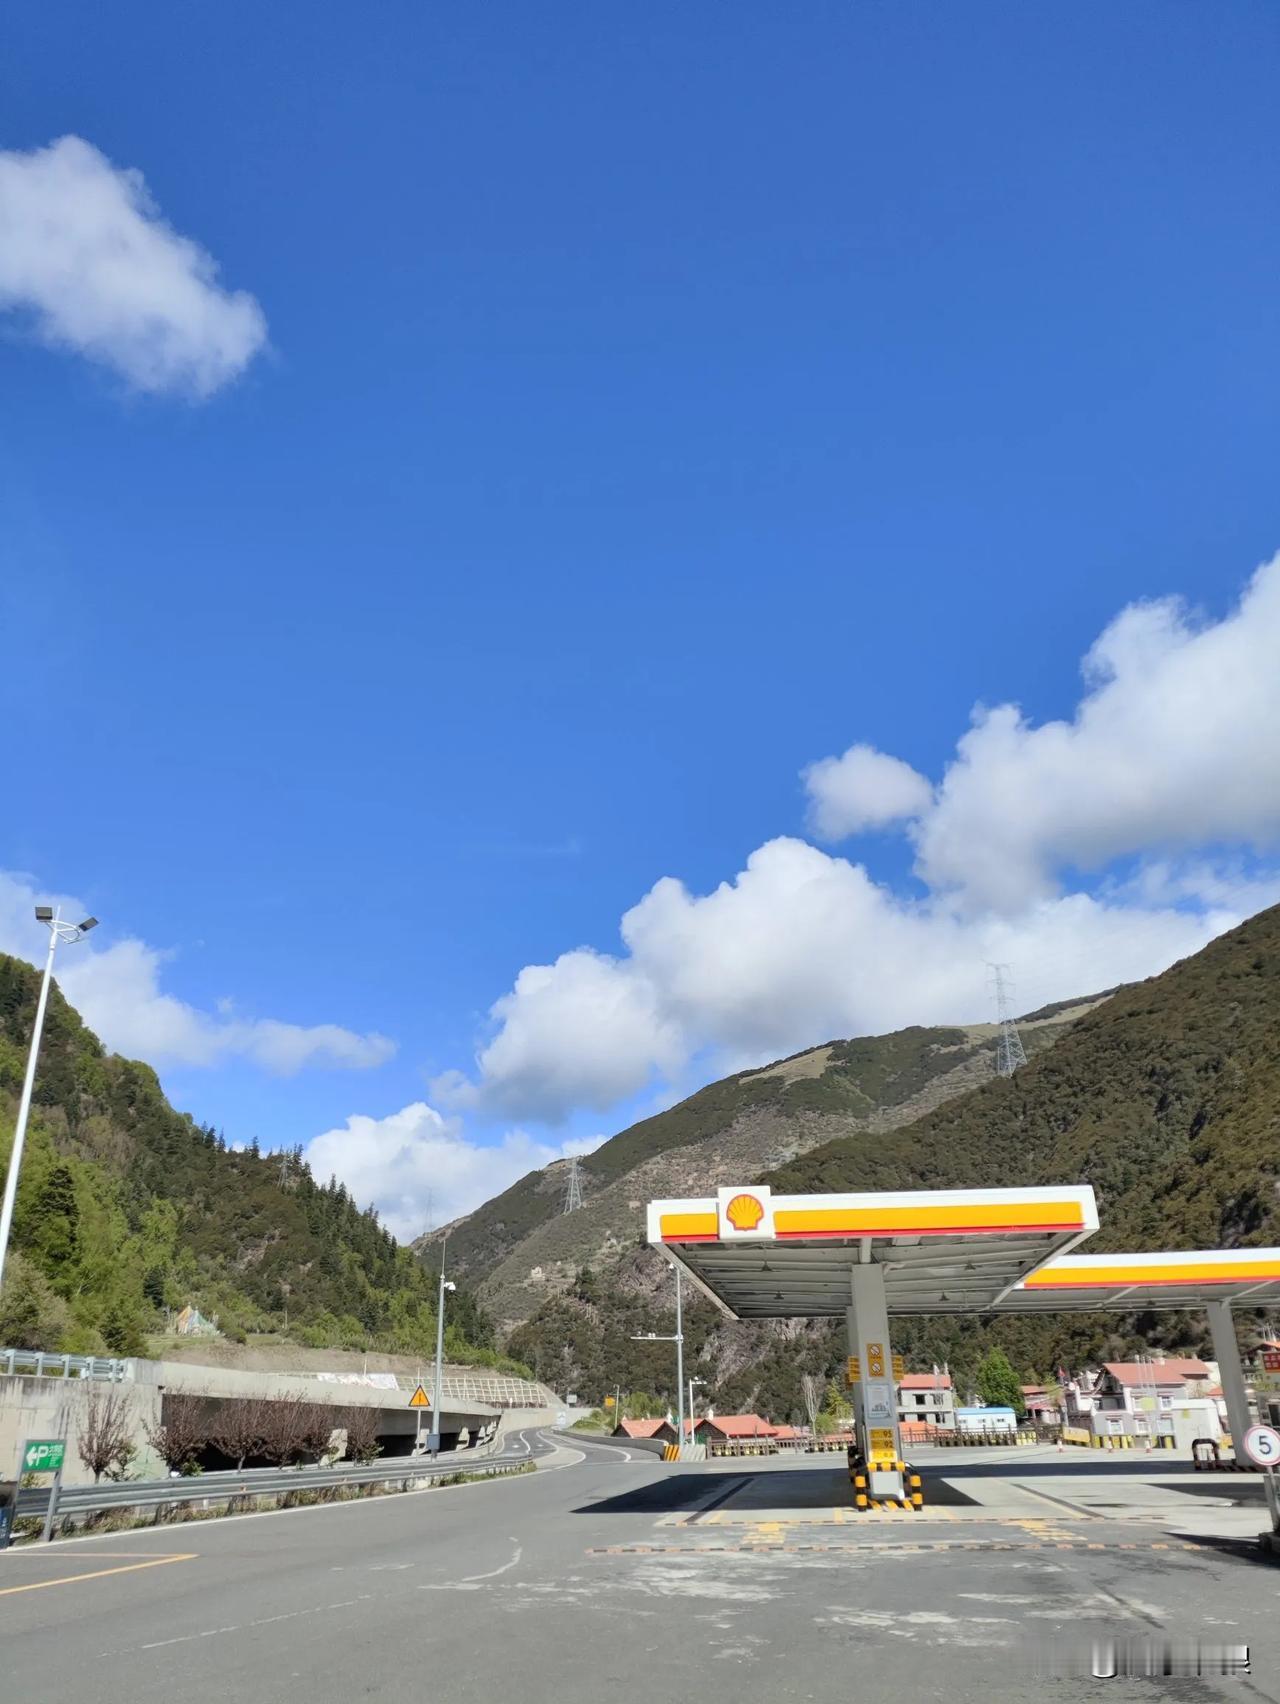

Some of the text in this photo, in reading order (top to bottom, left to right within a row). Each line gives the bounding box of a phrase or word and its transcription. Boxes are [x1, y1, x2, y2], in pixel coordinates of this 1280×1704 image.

[883, 1430, 893, 1438] 95
[1259, 1435, 1271, 1455] 5
[36, 1445, 49, 1466] P
